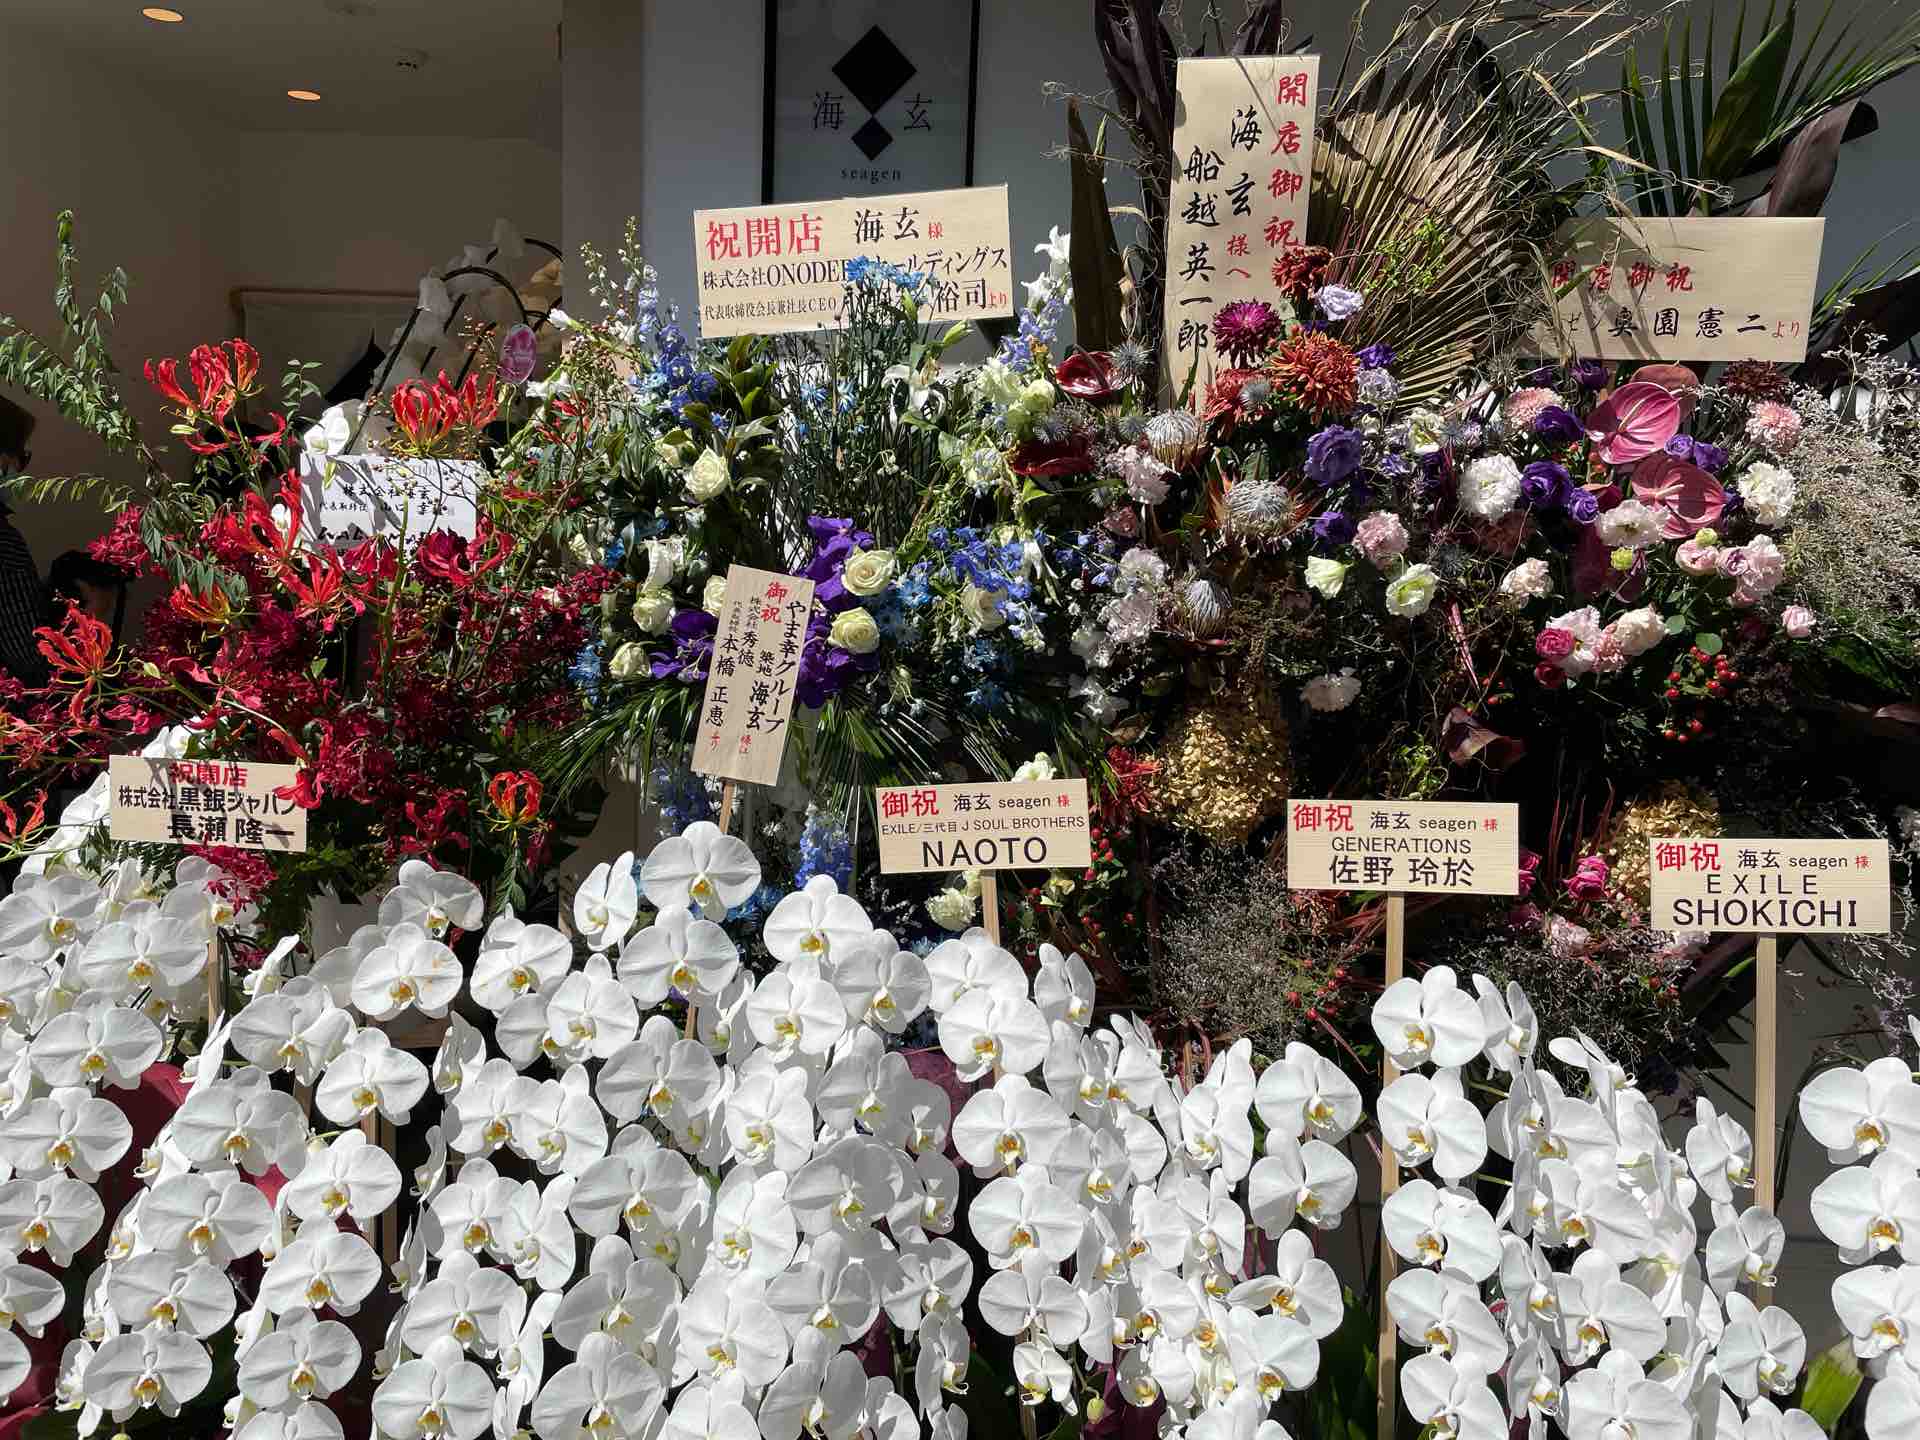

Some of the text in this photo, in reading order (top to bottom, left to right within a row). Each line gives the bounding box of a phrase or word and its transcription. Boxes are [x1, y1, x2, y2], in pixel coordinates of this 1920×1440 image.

[812, 91, 932, 131] 海 玄
[1264, 72, 1308, 247] 開店御祝
[840, 167, 901, 184] seagen
[1225, 105, 1262, 278] 海玄様へ
[704, 207, 943, 261] 祝開店 海玄 様
[1177, 145, 1226, 352] 船越英一郎
[760, 582, 788, 624] 御祝
[168, 760, 249, 787] 祝開店
[881, 789, 1071, 818] 御祝 海玄 seagen 様
[1293, 804, 1498, 833] 御祝 海玄 seagen 様
[168, 814, 295, 845] 長瀬 隆一
[881, 816, 1085, 836] EXILE/三代目 J SOUL BROTHERS
[922, 837, 1048, 868] NAOTO
[1331, 836, 1472, 854] GENERATIONS
[1655, 842, 1872, 871] 御祝 海玄 seagen 様
[1329, 855, 1475, 887] 佐野 玲於
[1706, 874, 1819, 894] EXILE
[1672, 899, 1857, 927] SHOKICHI
